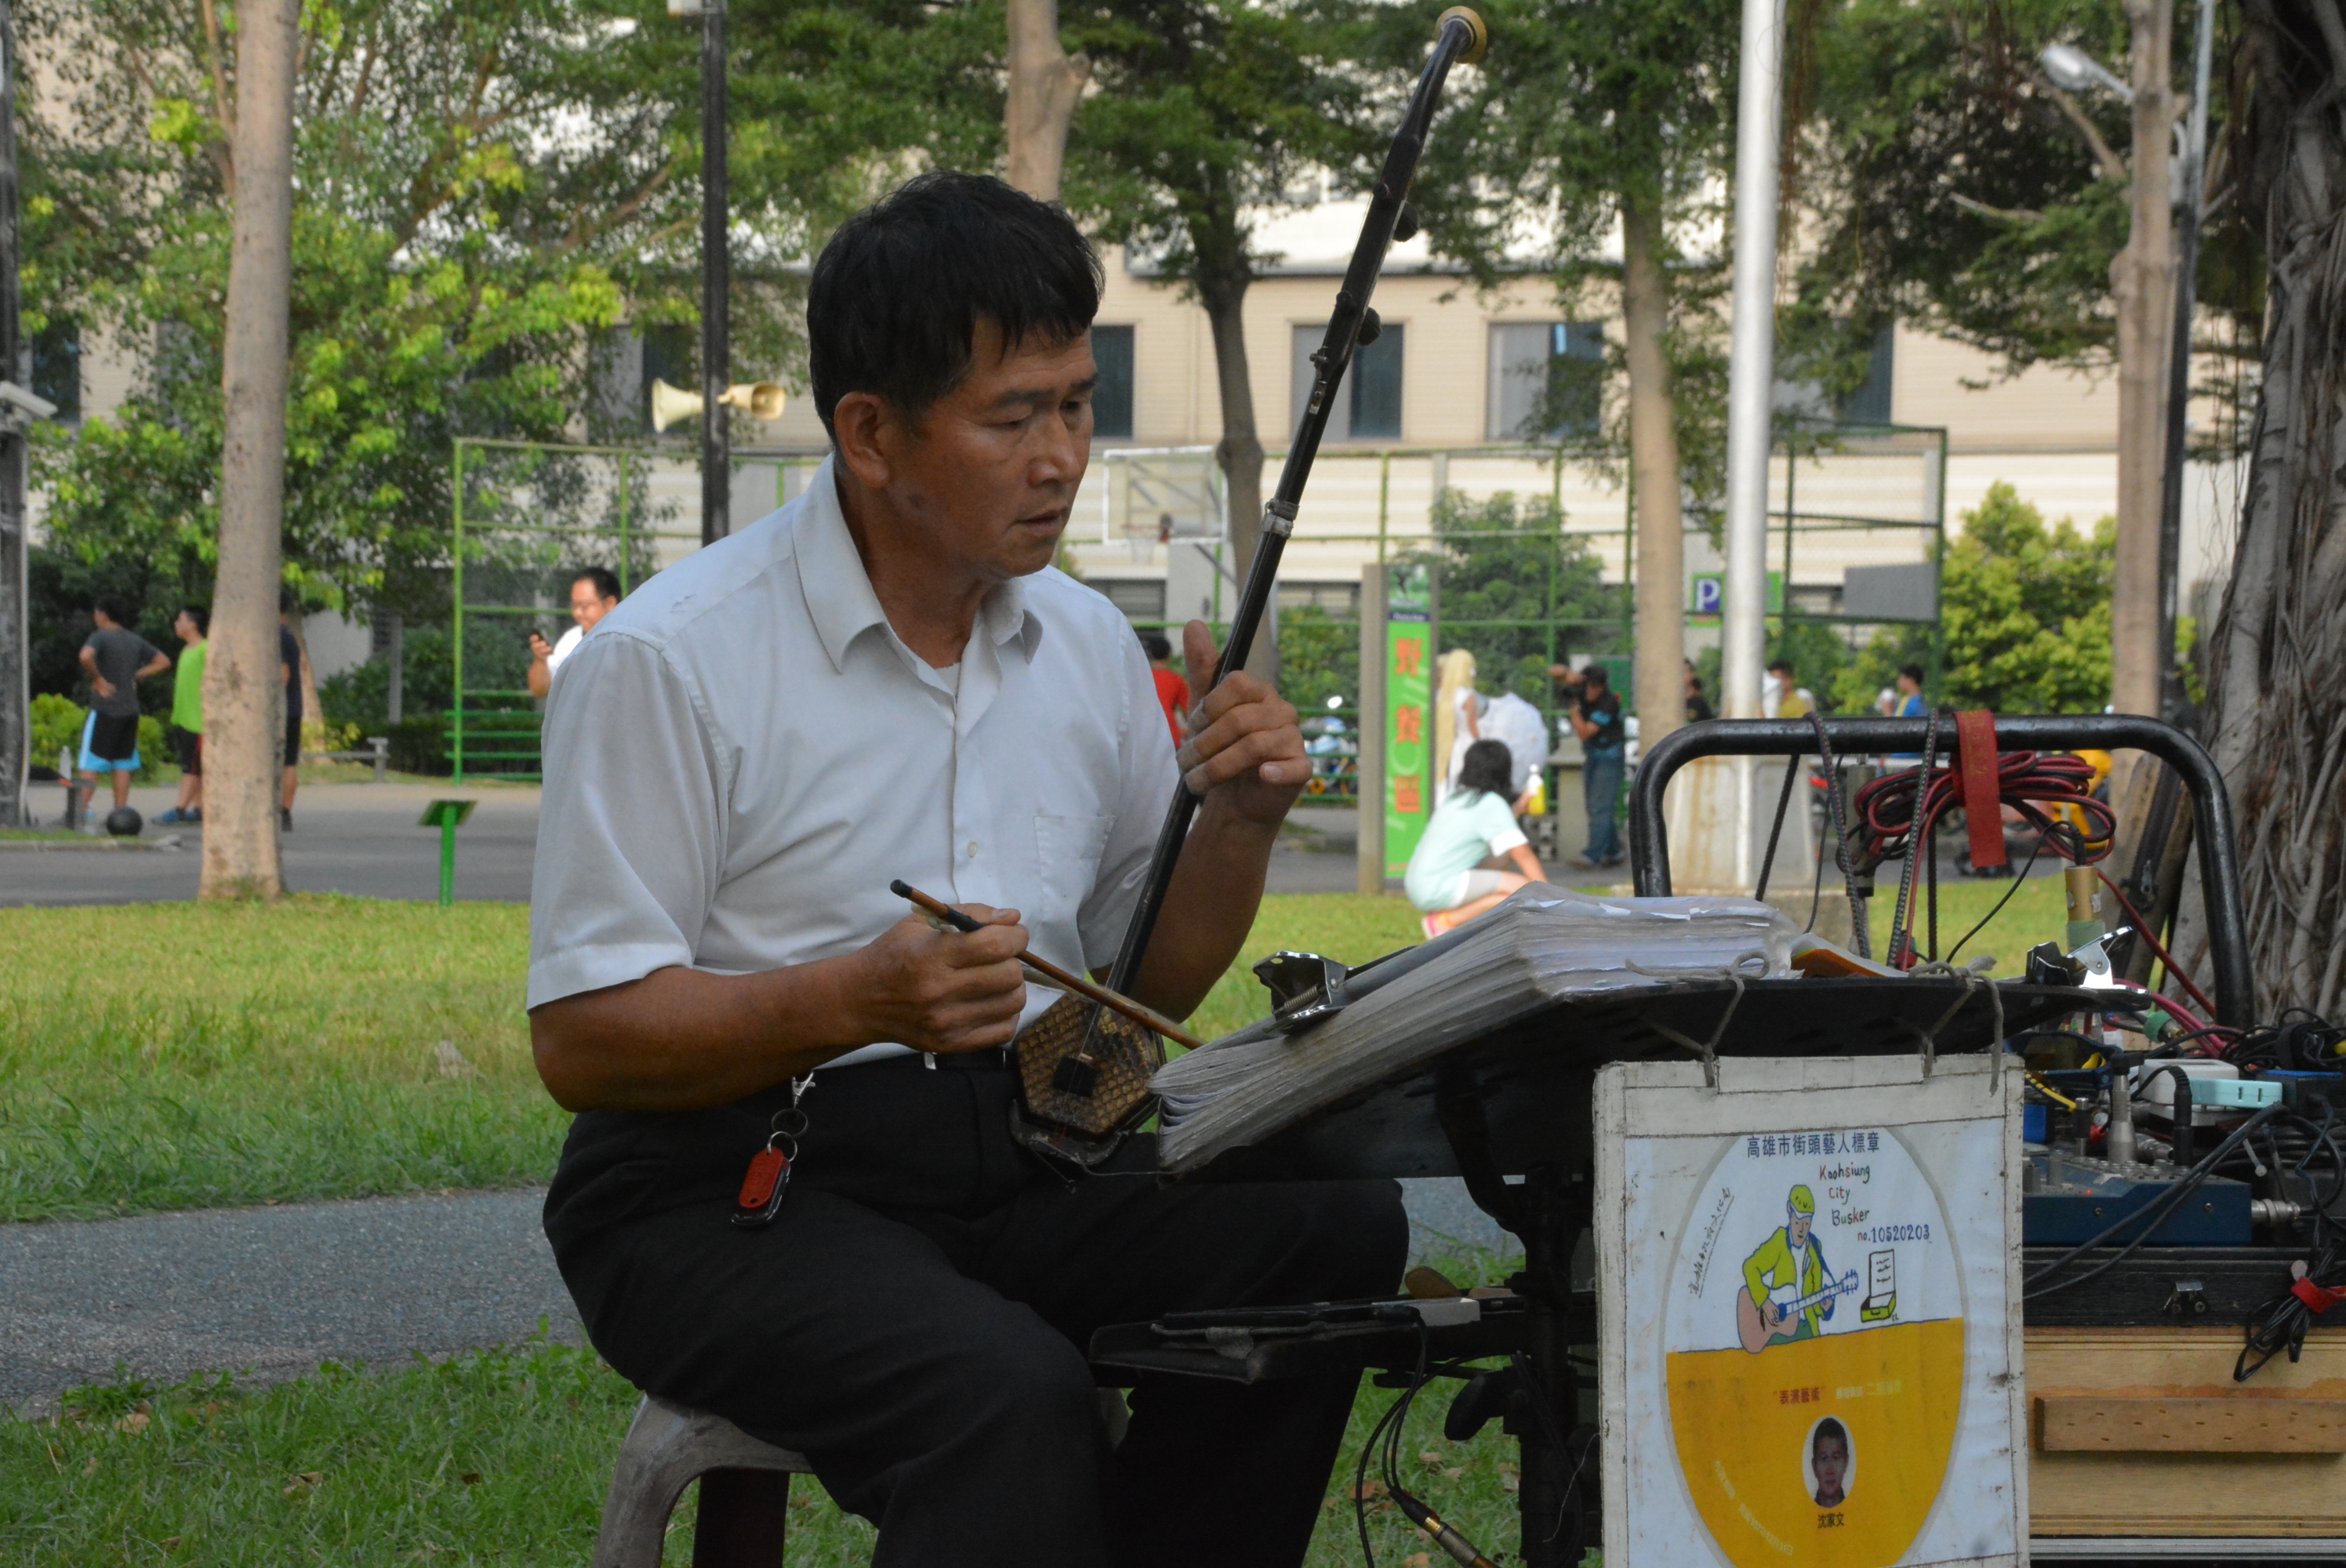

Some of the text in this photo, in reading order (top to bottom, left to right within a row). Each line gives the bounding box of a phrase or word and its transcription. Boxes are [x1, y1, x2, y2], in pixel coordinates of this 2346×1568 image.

[1695, 578, 1720, 612] P
[1747, 1131, 1879, 1159] 高雄市街頭藝人標章
[1819, 1162, 1870, 1184] Kaohsiung
[1832, 1207, 1870, 1226] Busker
[1818, 1512, 1845, 1529] 沈家文
